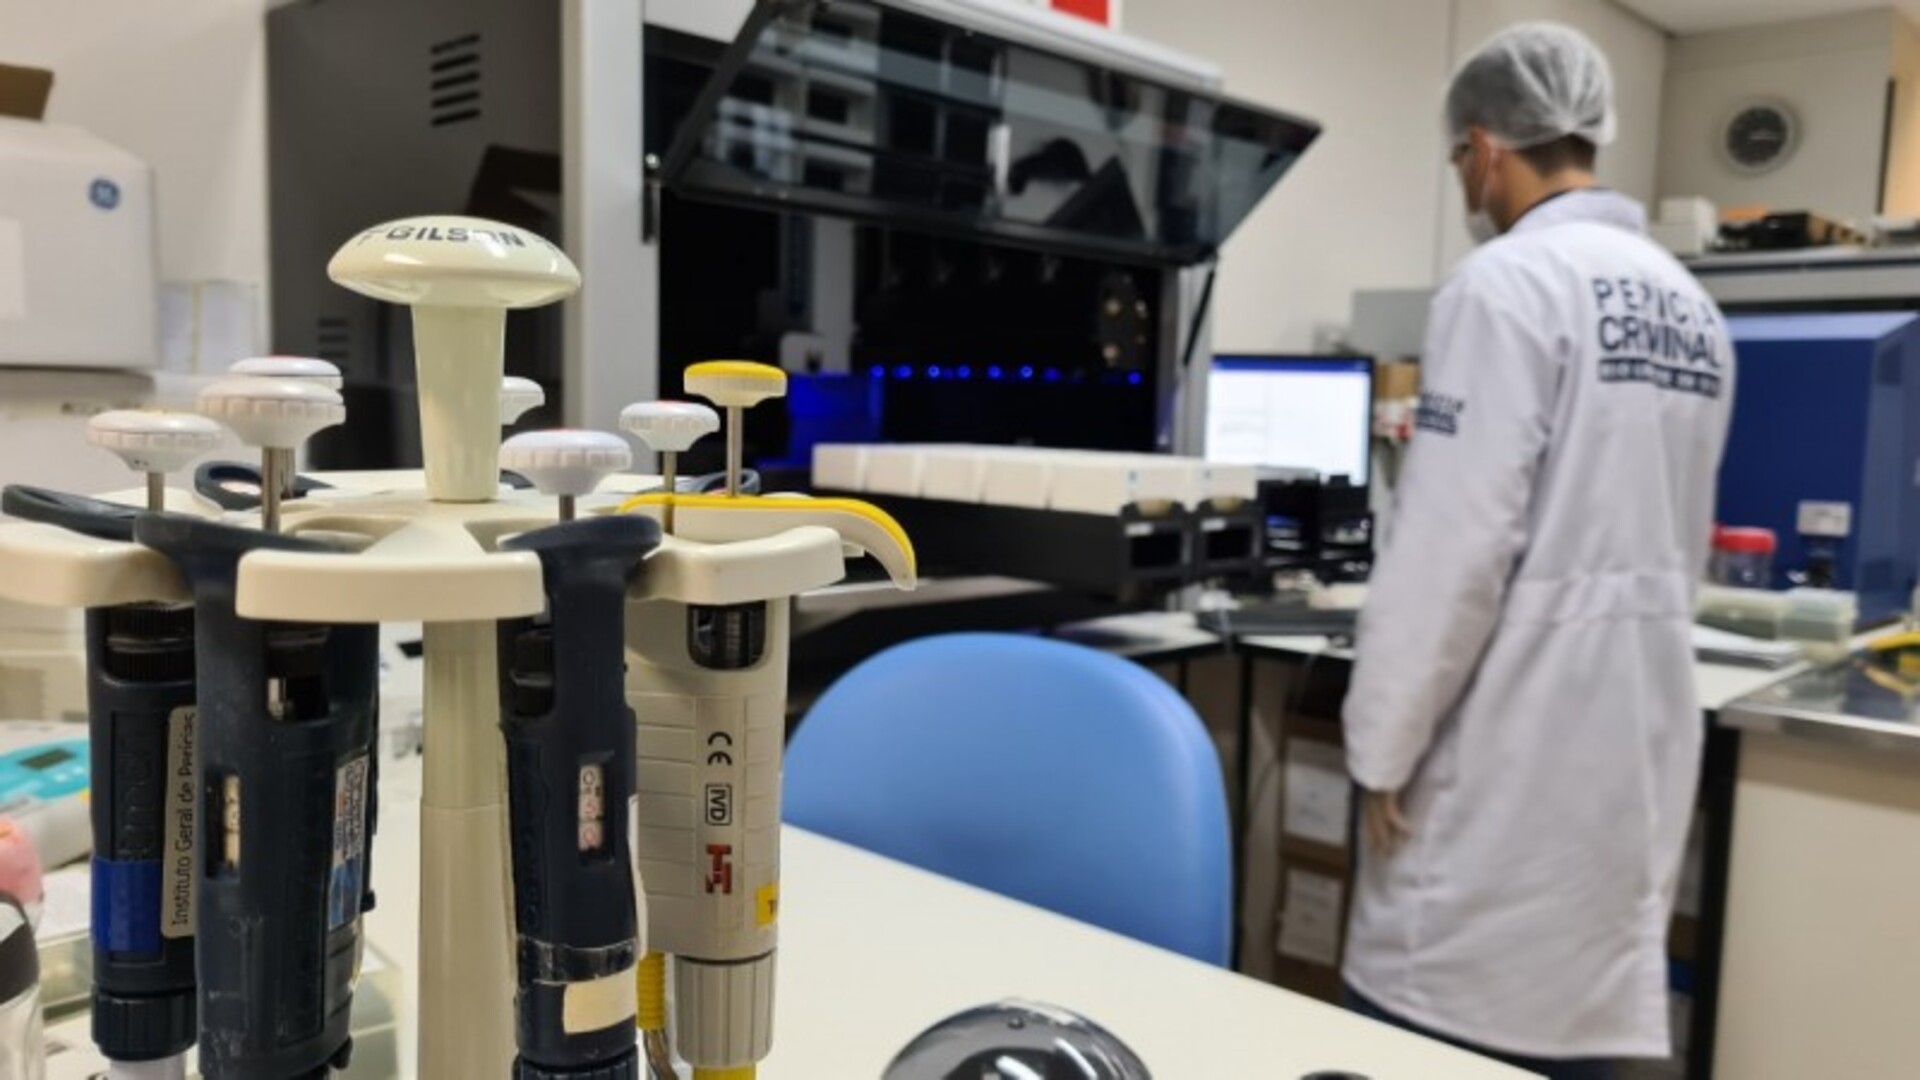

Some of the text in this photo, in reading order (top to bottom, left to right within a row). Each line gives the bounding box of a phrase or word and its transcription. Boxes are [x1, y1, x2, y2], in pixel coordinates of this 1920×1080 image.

[177, 781, 195, 804] de
[709, 788, 727, 822] IVD
[175, 808, 194, 852] Geral
[171, 857, 191, 926] Instituto
